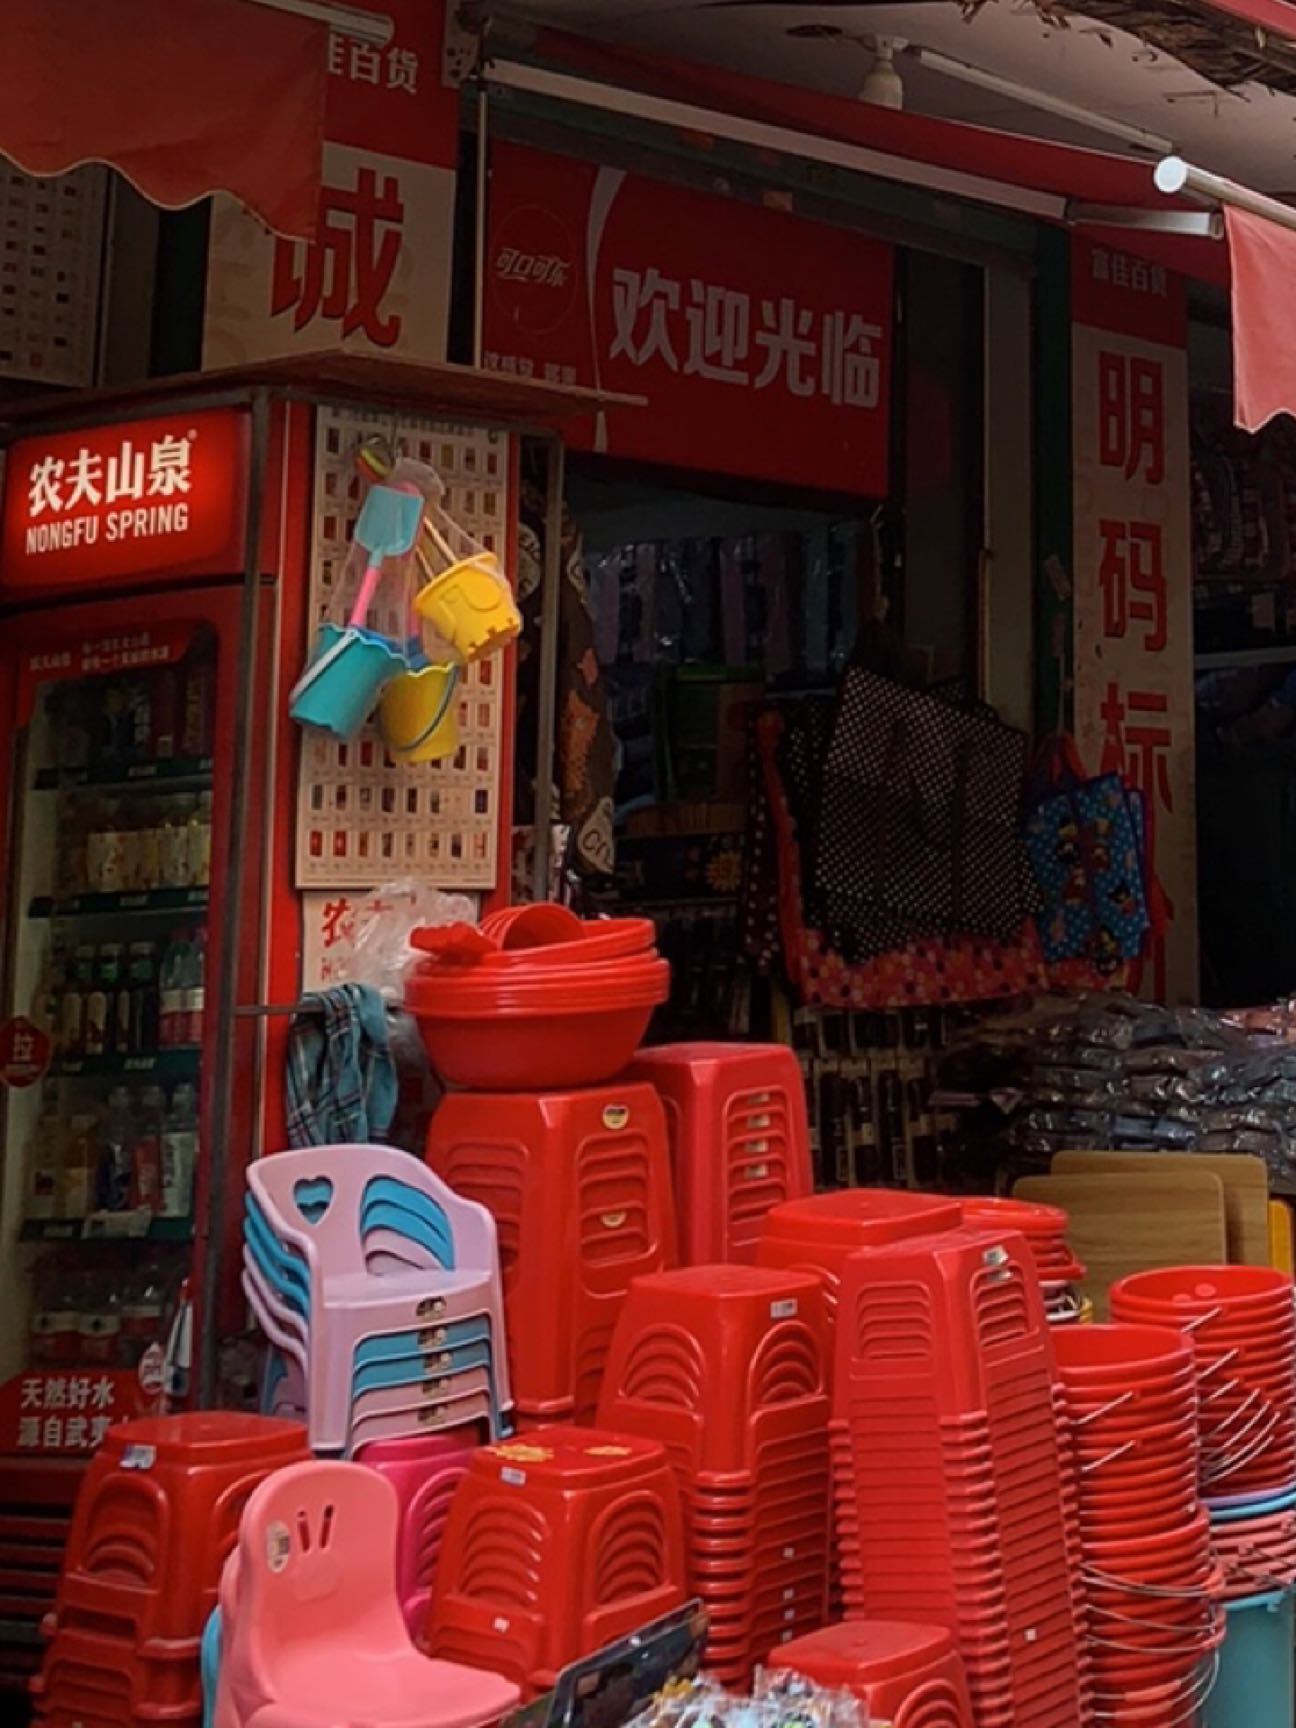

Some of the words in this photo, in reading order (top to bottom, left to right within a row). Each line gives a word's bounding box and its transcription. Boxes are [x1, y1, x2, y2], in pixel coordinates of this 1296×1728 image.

[496, 247, 573, 288] 可口可乐
[1091, 247, 1168, 299] 富佳百货
[609, 265, 885, 409] 欢迎光临
[28, 434, 191, 518] 农夫山泉
[25, 514, 99, 556] NONGFU
[105, 502, 188, 542] SPRING
[1100, 350, 1174, 1000] 明码标
[20, 1375, 116, 1411] 天然好水
